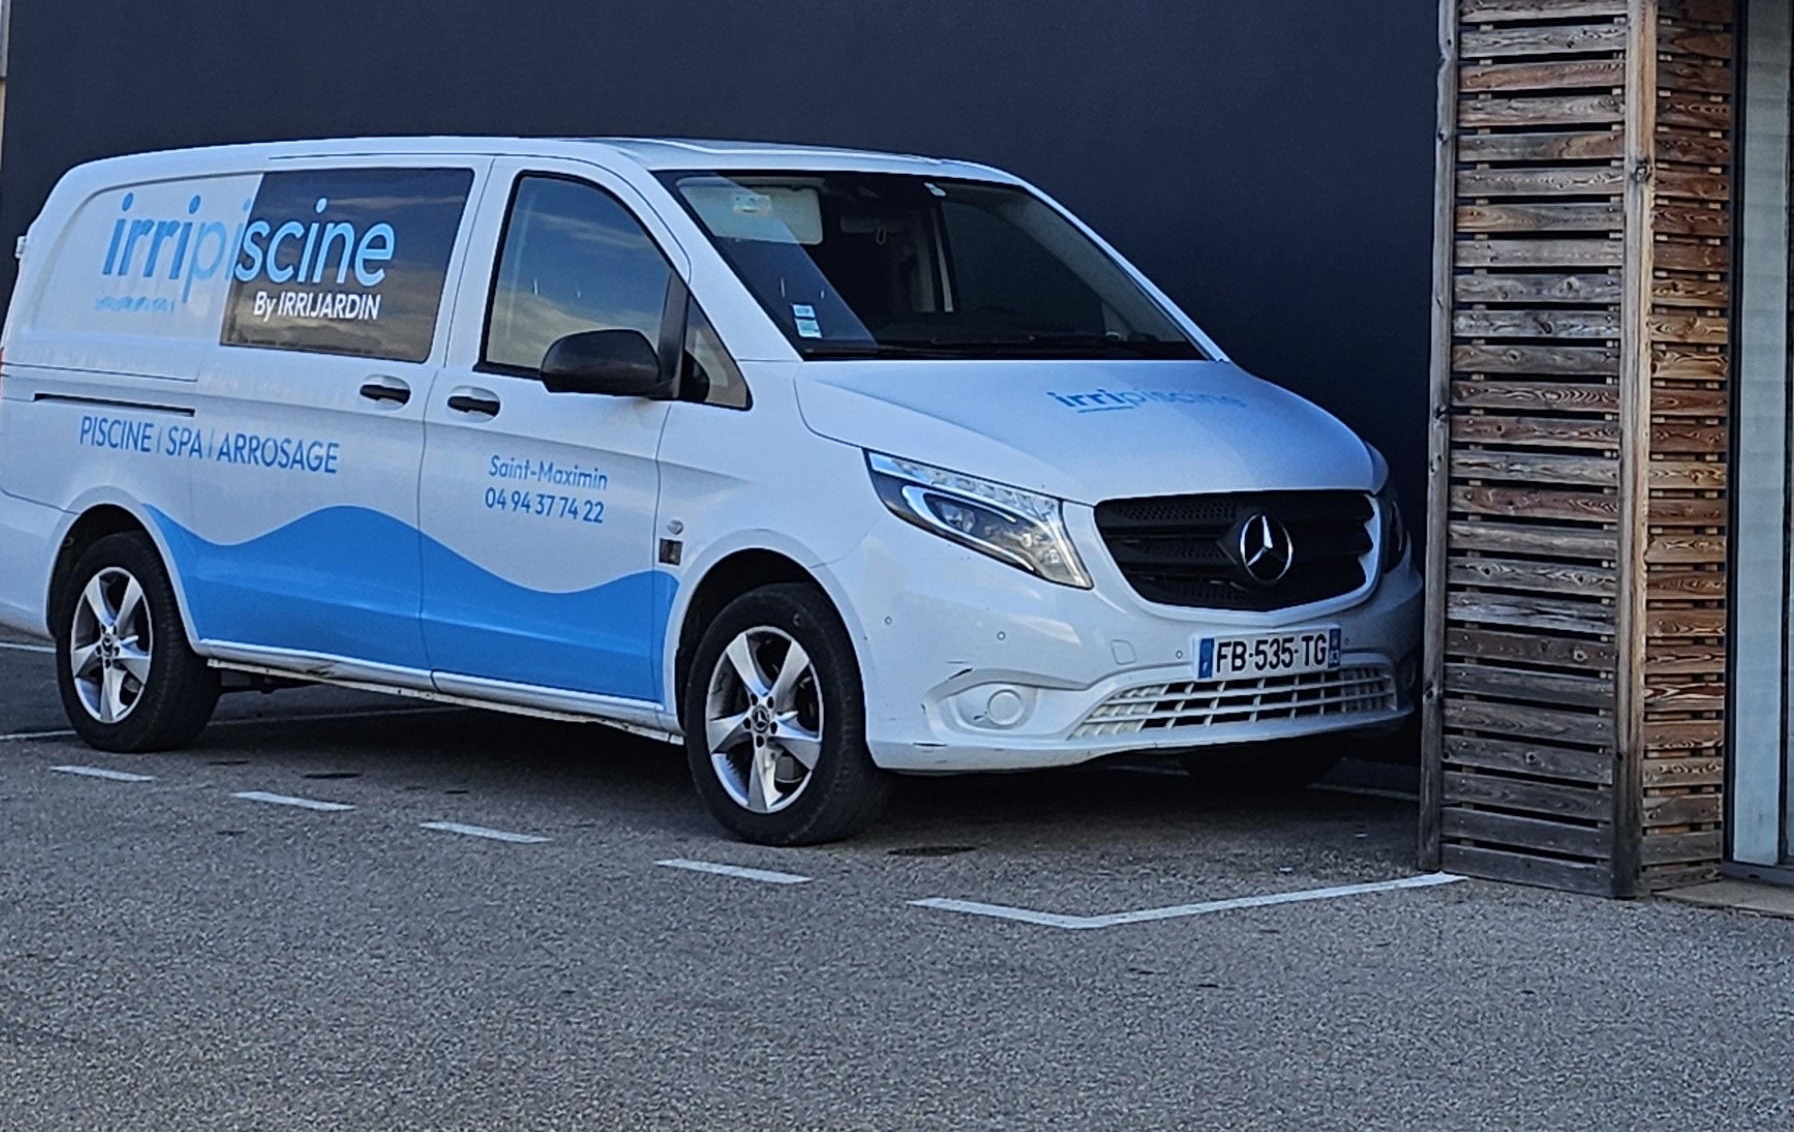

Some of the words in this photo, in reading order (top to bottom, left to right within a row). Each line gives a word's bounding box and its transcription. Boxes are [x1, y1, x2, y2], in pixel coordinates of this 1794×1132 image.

[102, 192, 395, 304] irripiscine
[254, 291, 278, 322] By
[277, 291, 381, 320] IRRIJARDIN
[79, 416, 154, 453] PISCINE
[165, 425, 203, 459] SPA
[216, 432, 340, 474] ARROSAGE
[489, 454, 608, 491] Saint-Maximin
[485, 487, 507, 511] 04
[511, 490, 531, 514] 94
[534, 494, 556, 517] 37
[559, 496, 579, 520] 74
[582, 499, 605, 524] 22
